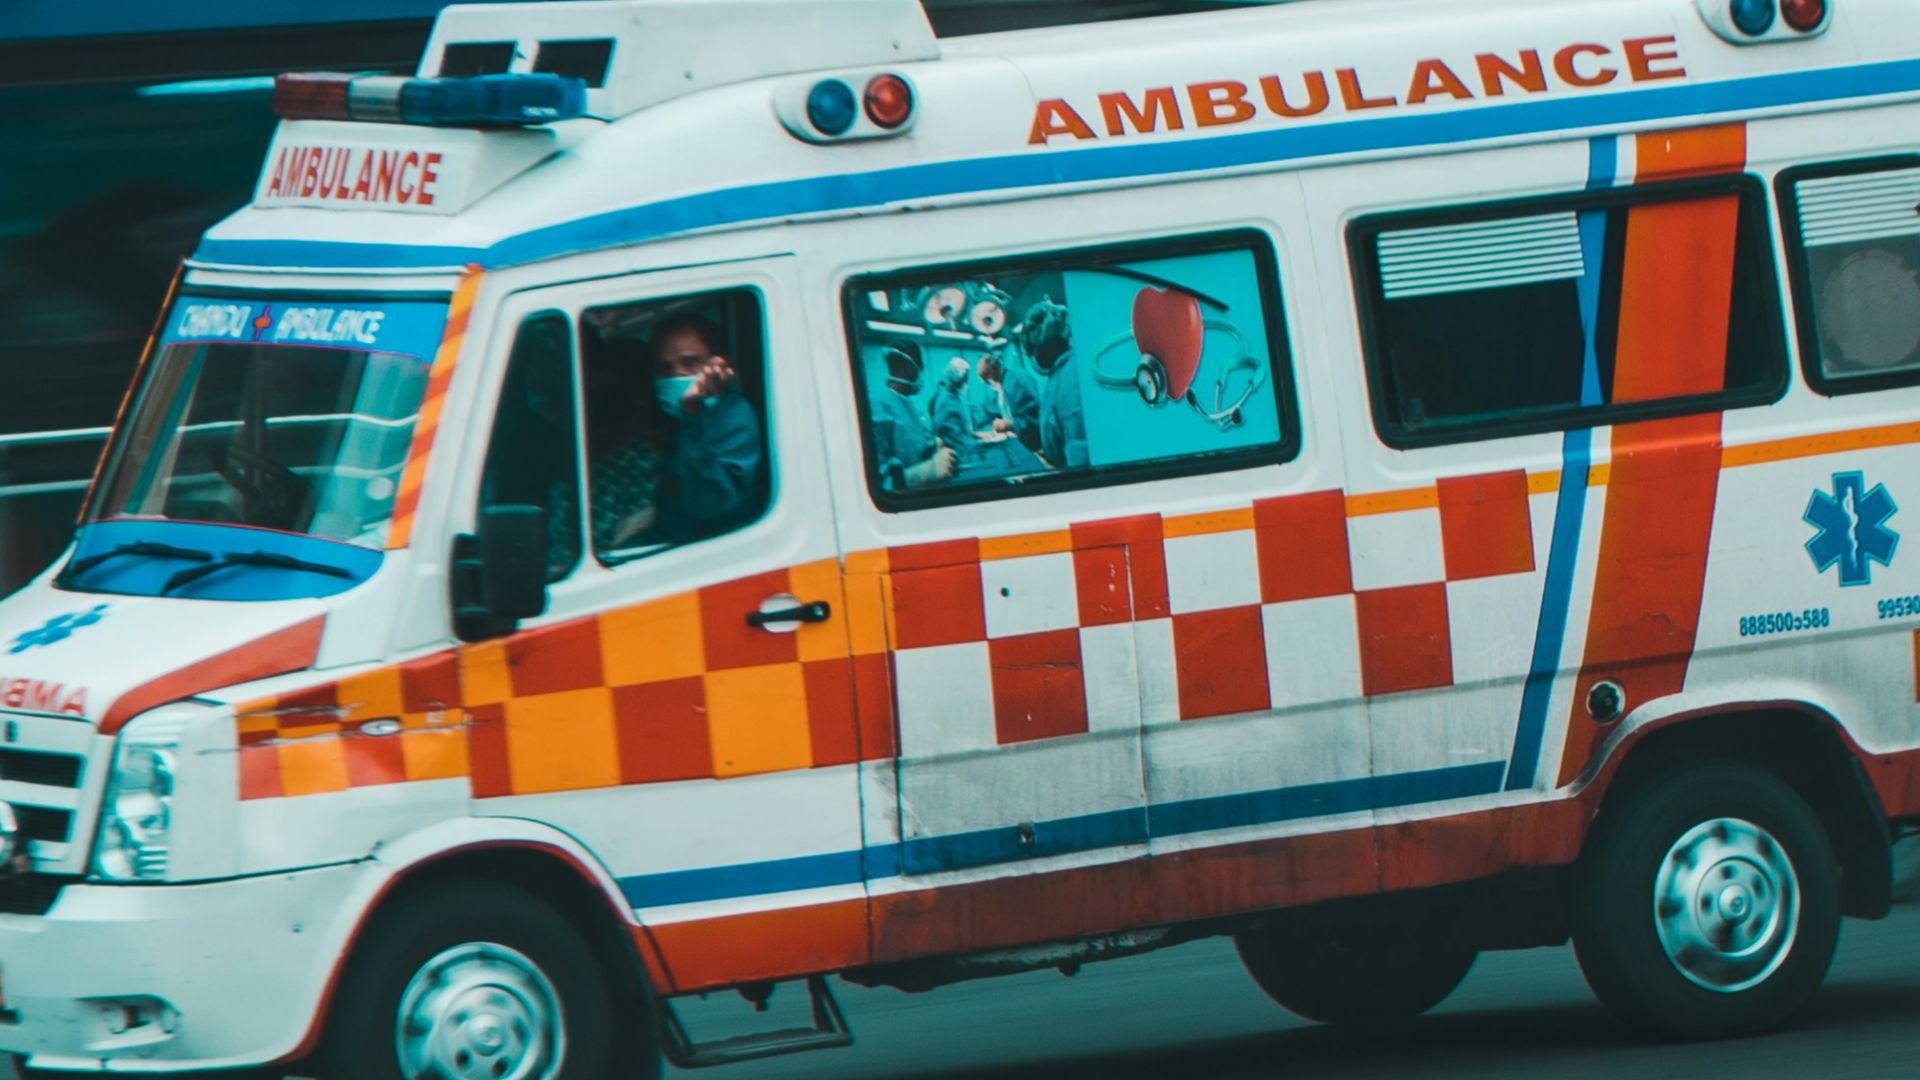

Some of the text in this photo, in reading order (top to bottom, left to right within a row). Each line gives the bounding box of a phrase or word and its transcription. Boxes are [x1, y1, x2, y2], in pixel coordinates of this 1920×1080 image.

[1027, 35, 1687, 145] AMBULANCE
[266, 146, 442, 206] AMBULANCE
[274, 307, 385, 345] AMBULANCE
